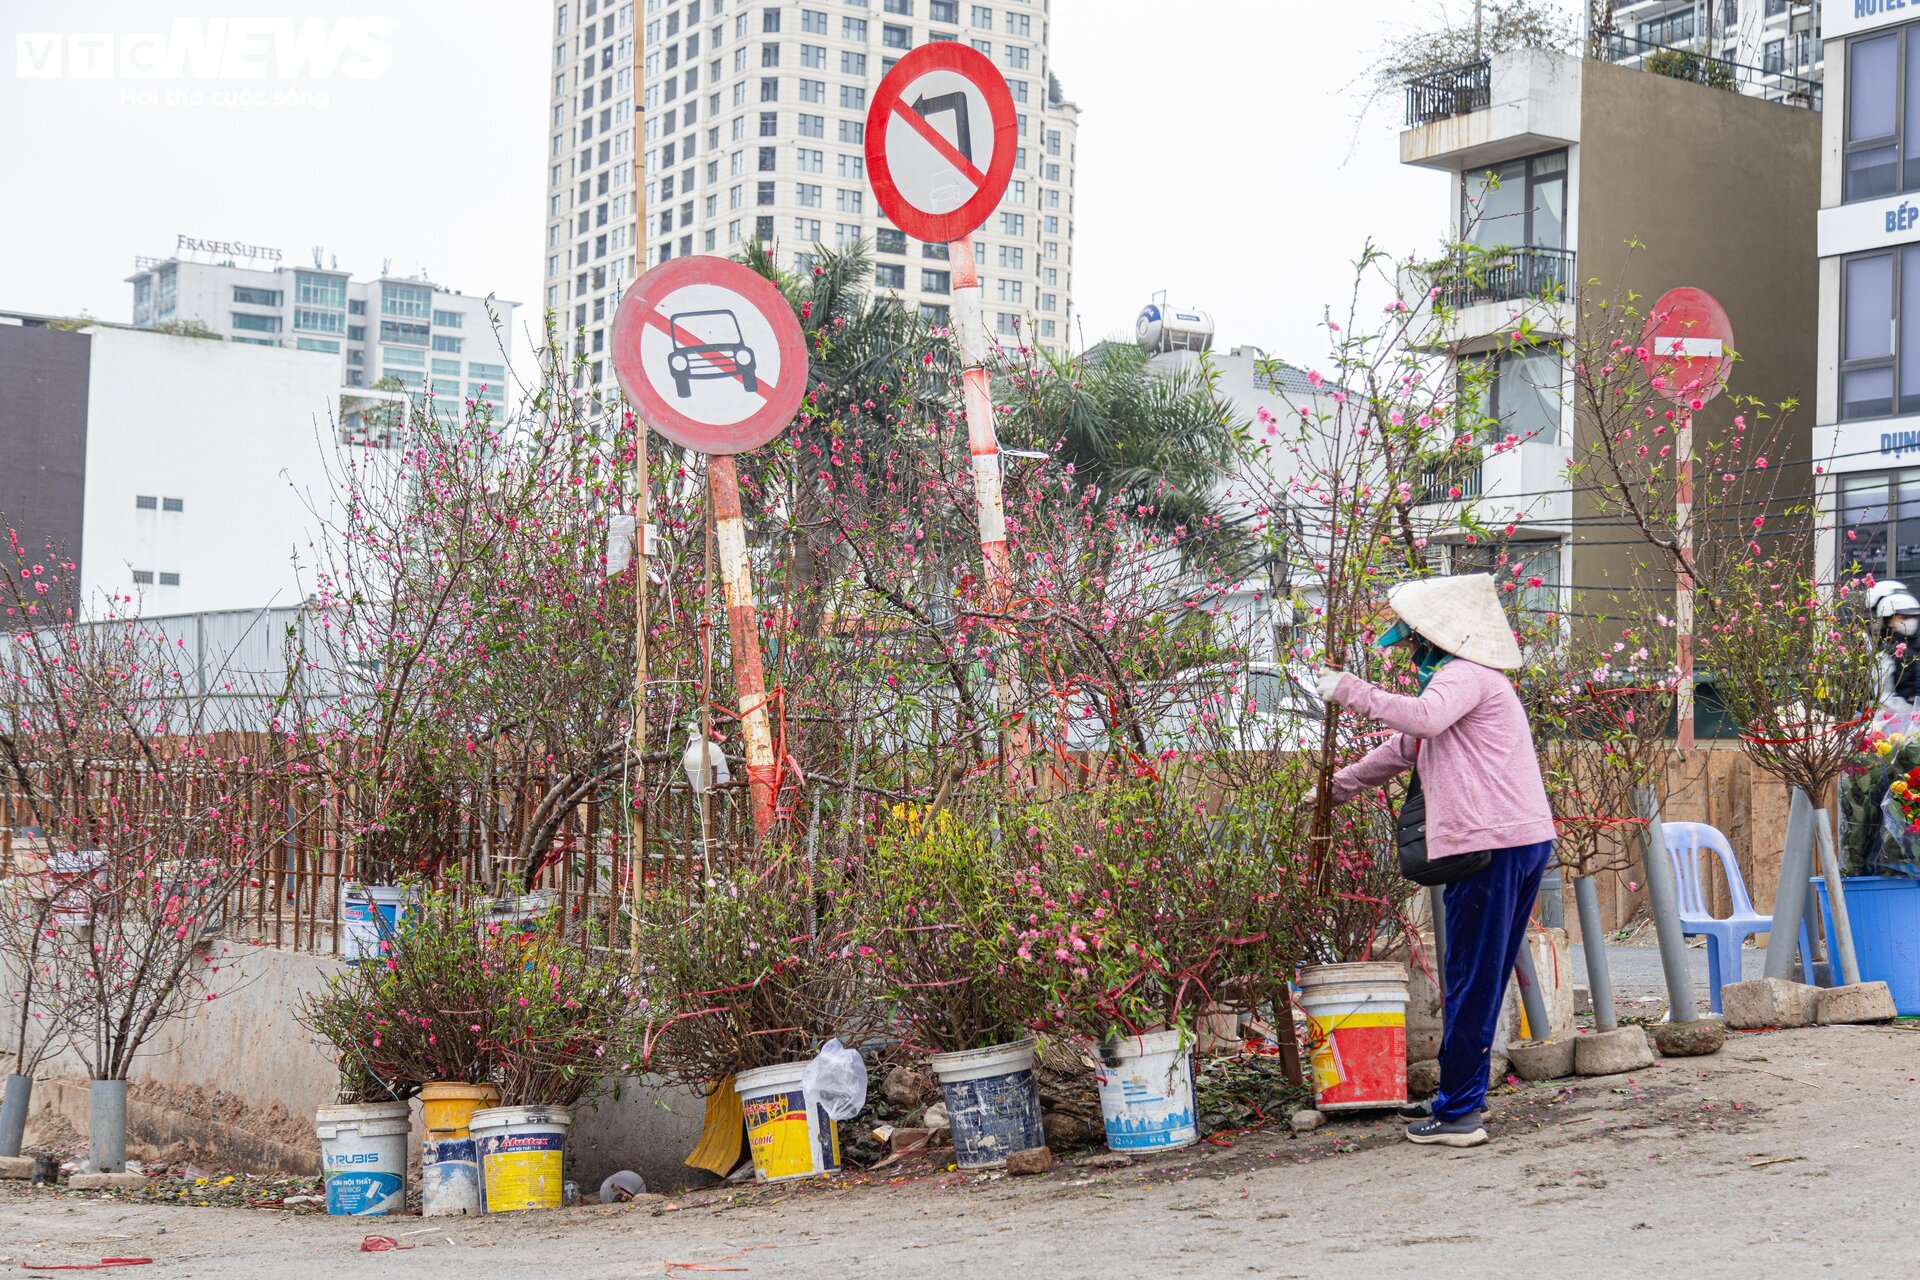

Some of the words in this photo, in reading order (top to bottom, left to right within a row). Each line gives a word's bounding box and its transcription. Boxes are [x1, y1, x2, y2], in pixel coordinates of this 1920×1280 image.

[1885, 201, 1919, 232] BẾP
[336, 1153, 379, 1165] RUBIS
[343, 1178, 354, 1186] NỘI
[355, 1176, 371, 1185] THẤT
